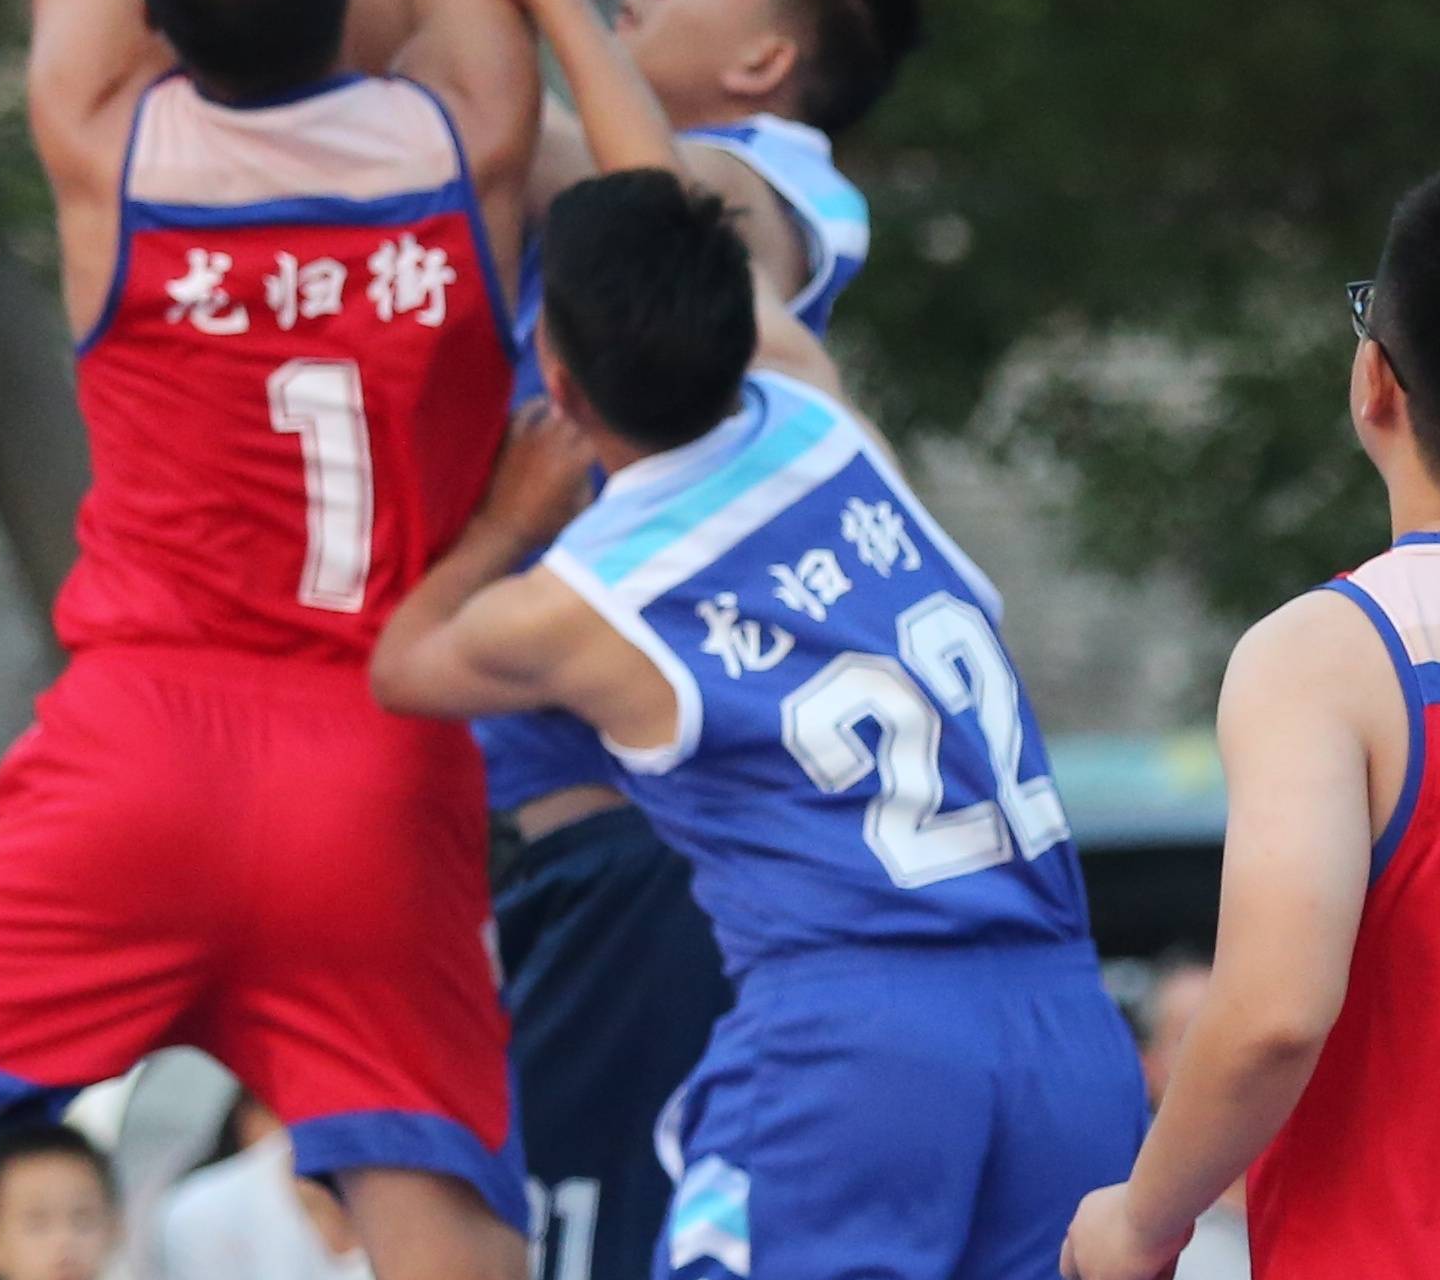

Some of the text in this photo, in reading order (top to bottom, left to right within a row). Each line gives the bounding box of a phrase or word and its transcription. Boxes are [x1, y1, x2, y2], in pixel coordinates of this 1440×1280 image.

[166, 231, 456, 334] 龙归街
[268, 357, 375, 615] 1
[697, 495, 923, 680] 龙归街
[780, 590, 1072, 890] 22
